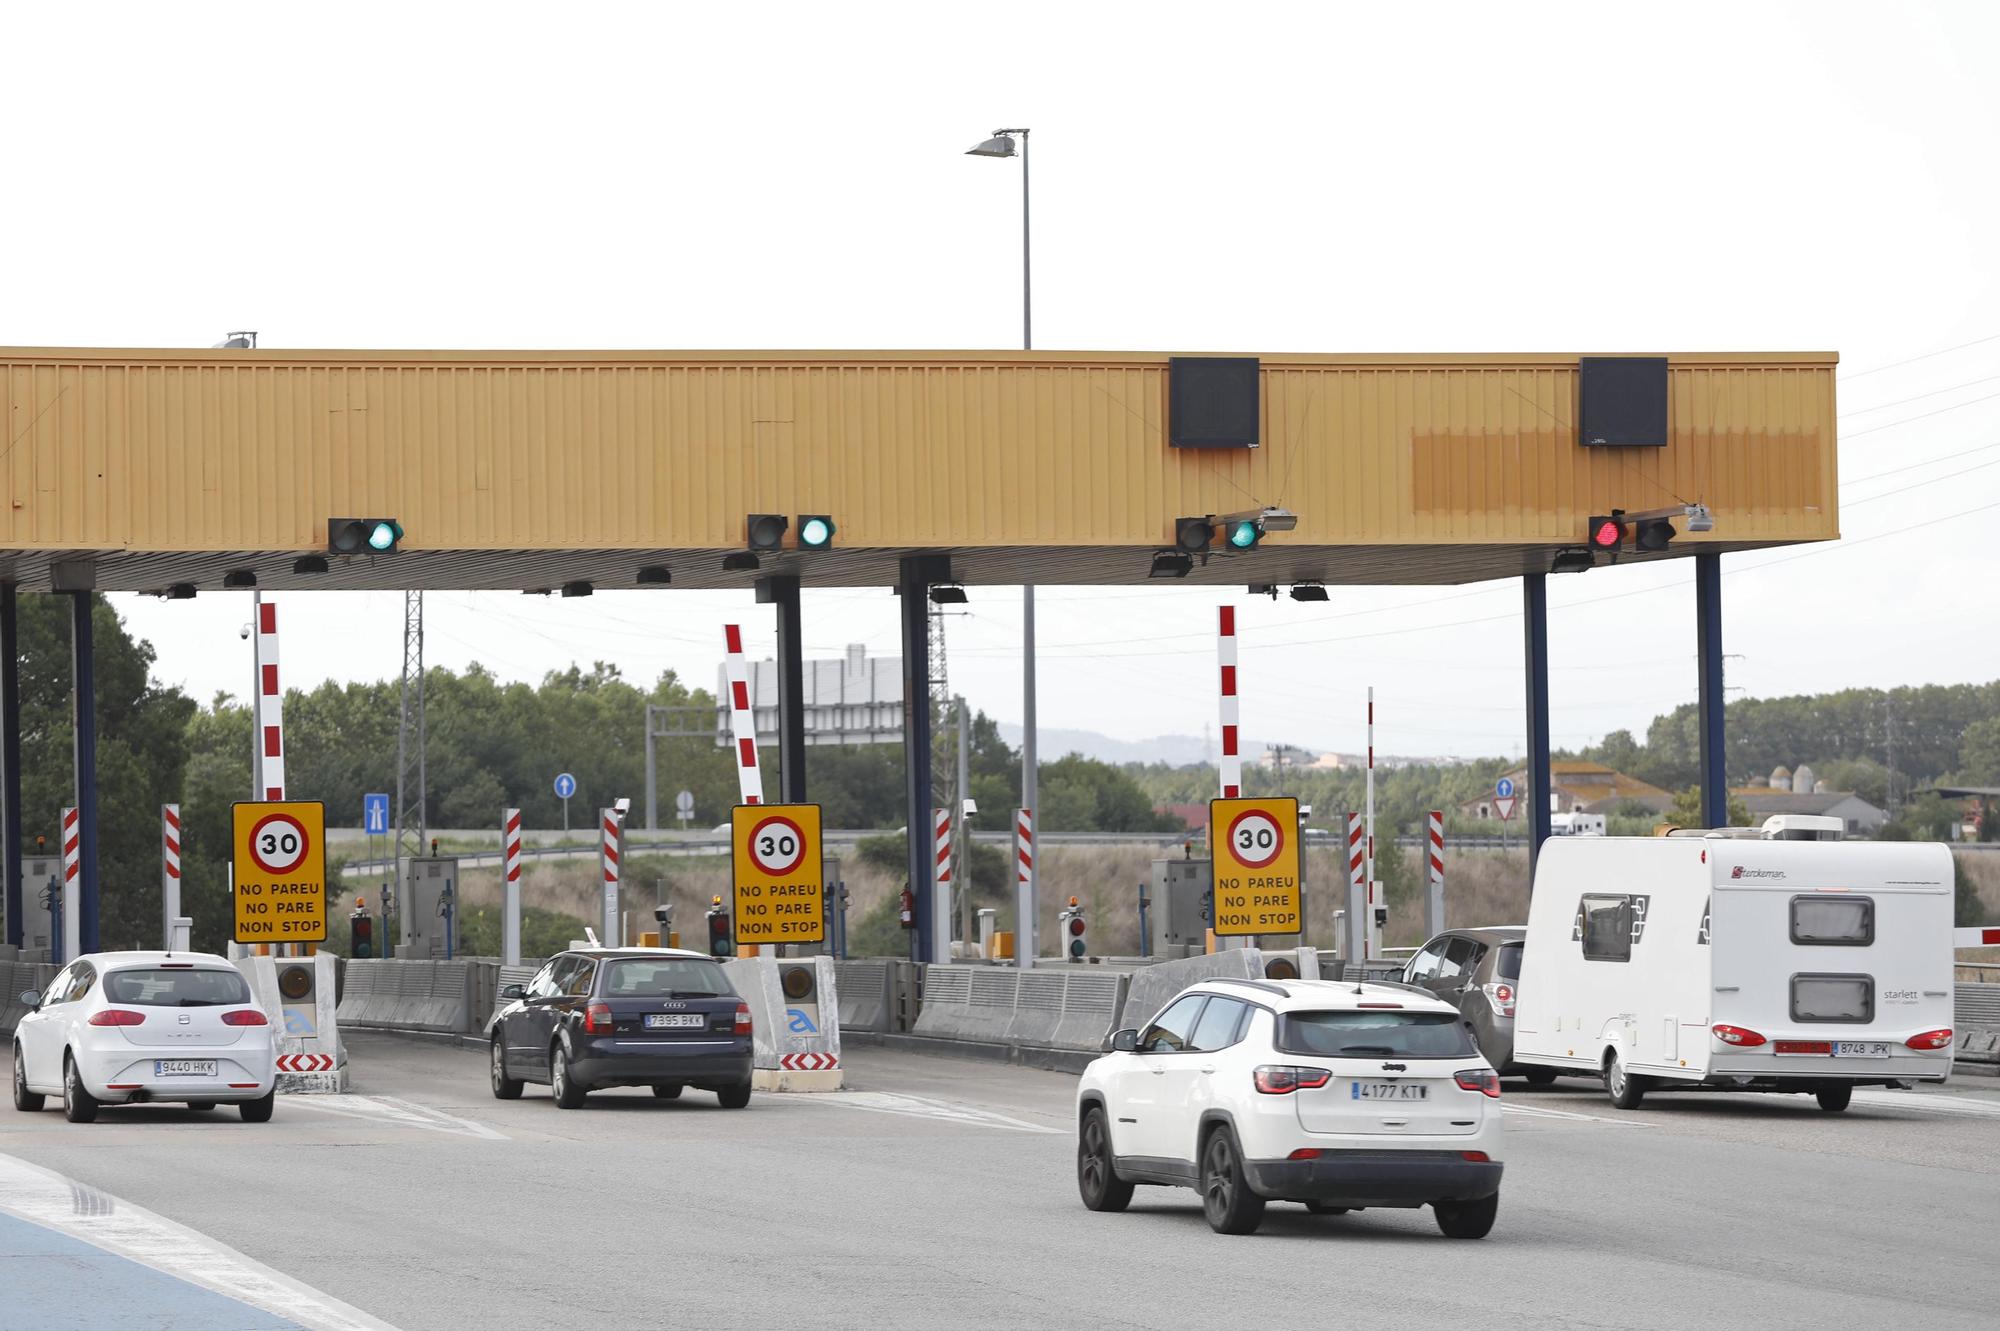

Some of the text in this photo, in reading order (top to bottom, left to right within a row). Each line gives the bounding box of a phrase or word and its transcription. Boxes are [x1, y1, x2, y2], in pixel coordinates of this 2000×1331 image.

[262, 834, 297, 854] 30
[1239, 829, 1272, 849] 30
[760, 836, 795, 856] 30
[240, 883, 319, 895] NO PAREU
[1220, 877, 1293, 889] NO PAREU
[740, 885, 816, 897] NO PAREU
[1225, 896, 1289, 907] NO PARE
[246, 902, 314, 914] NO PARE
[746, 903, 812, 915] NO PARE
[1220, 913, 1296, 926] NON STOP
[240, 921, 320, 932] NON STOP
[740, 922, 818, 934] NON STOP
[1884, 990, 1918, 999] starlett
[1841, 1043, 1865, 1054] 8748
[1870, 1044, 1888, 1054] JPK
[162, 1062, 214, 1071] 9440 HKK
[1362, 1084, 1397, 1098] 4177
